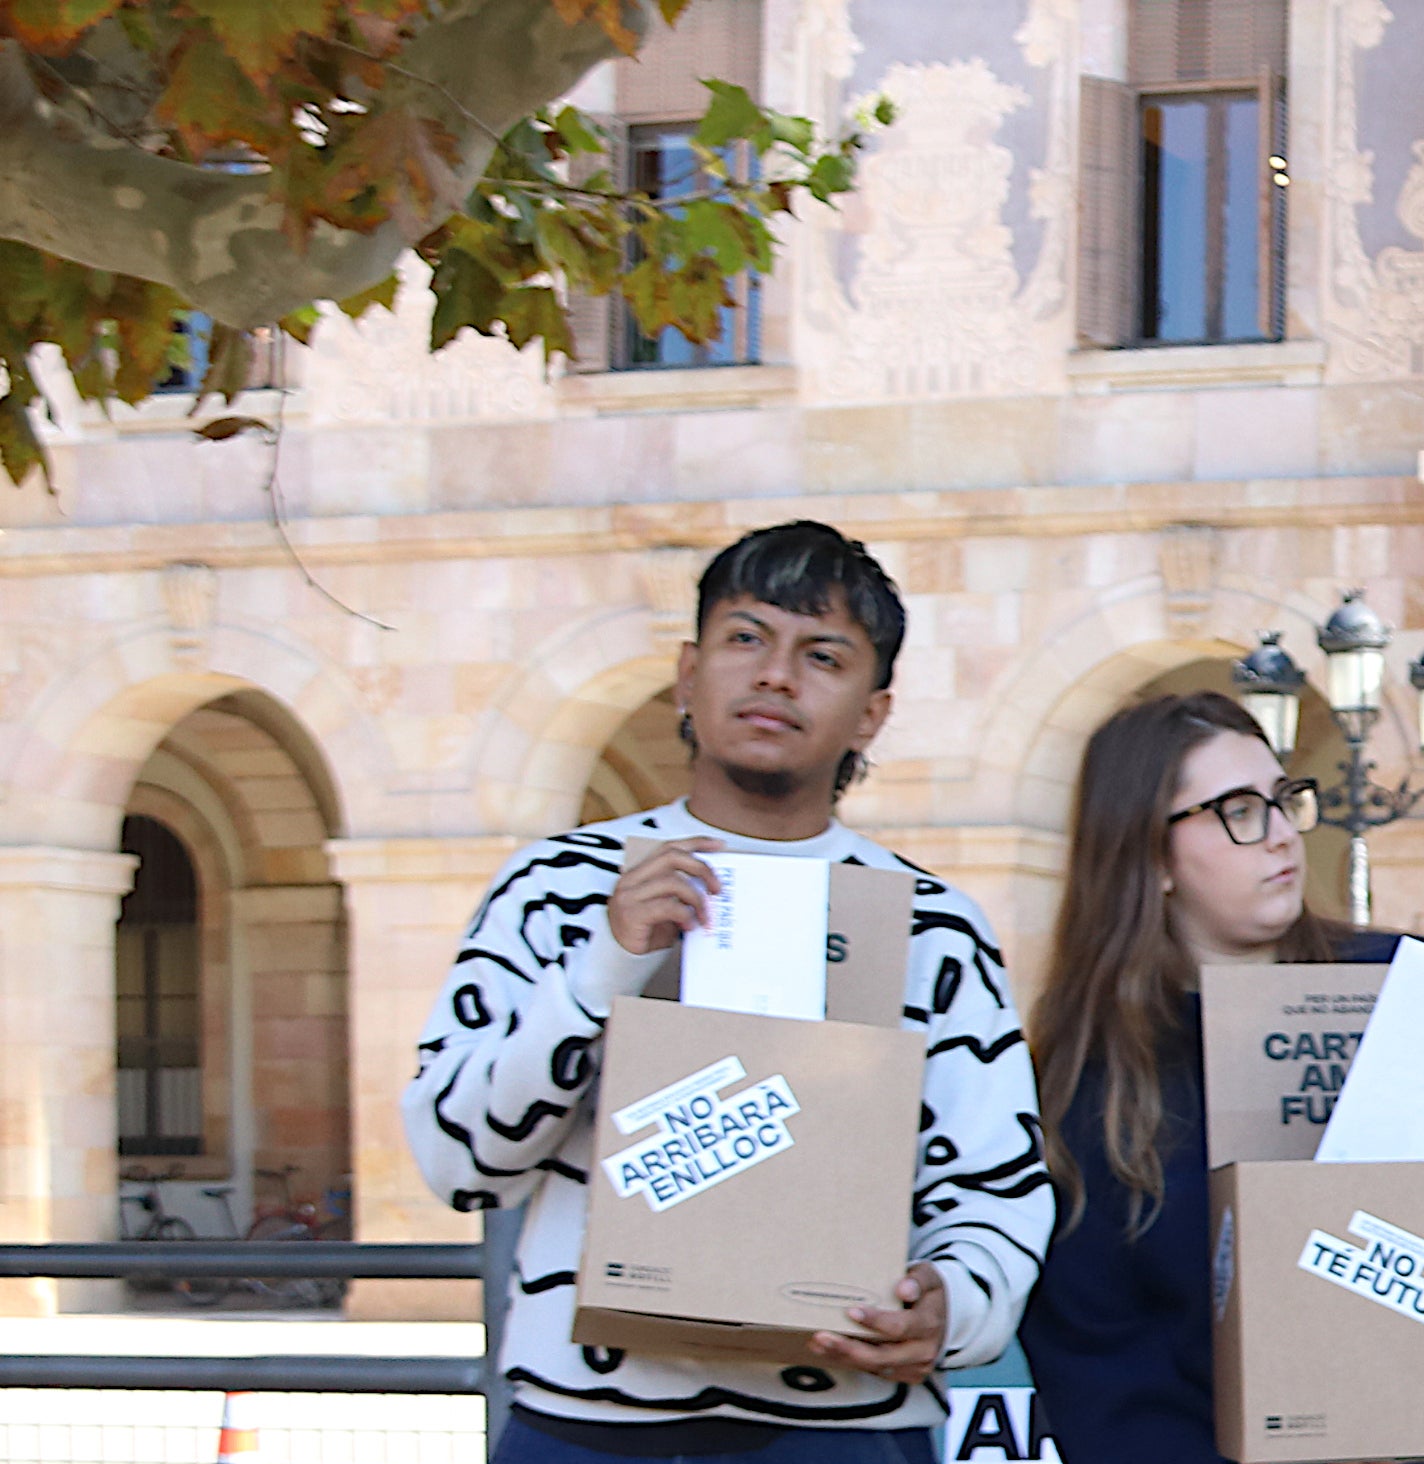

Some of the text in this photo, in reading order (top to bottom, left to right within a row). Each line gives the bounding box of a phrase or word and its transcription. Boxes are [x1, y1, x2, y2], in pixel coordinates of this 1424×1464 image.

[664, 1096, 713, 1134] NO
[622, 1085, 790, 1189] ARRIBARÀ
[650, 1123, 781, 1203] ENLLOC
[1313, 1242, 1352, 1278] TÉ
[1369, 1242, 1416, 1277] NO
